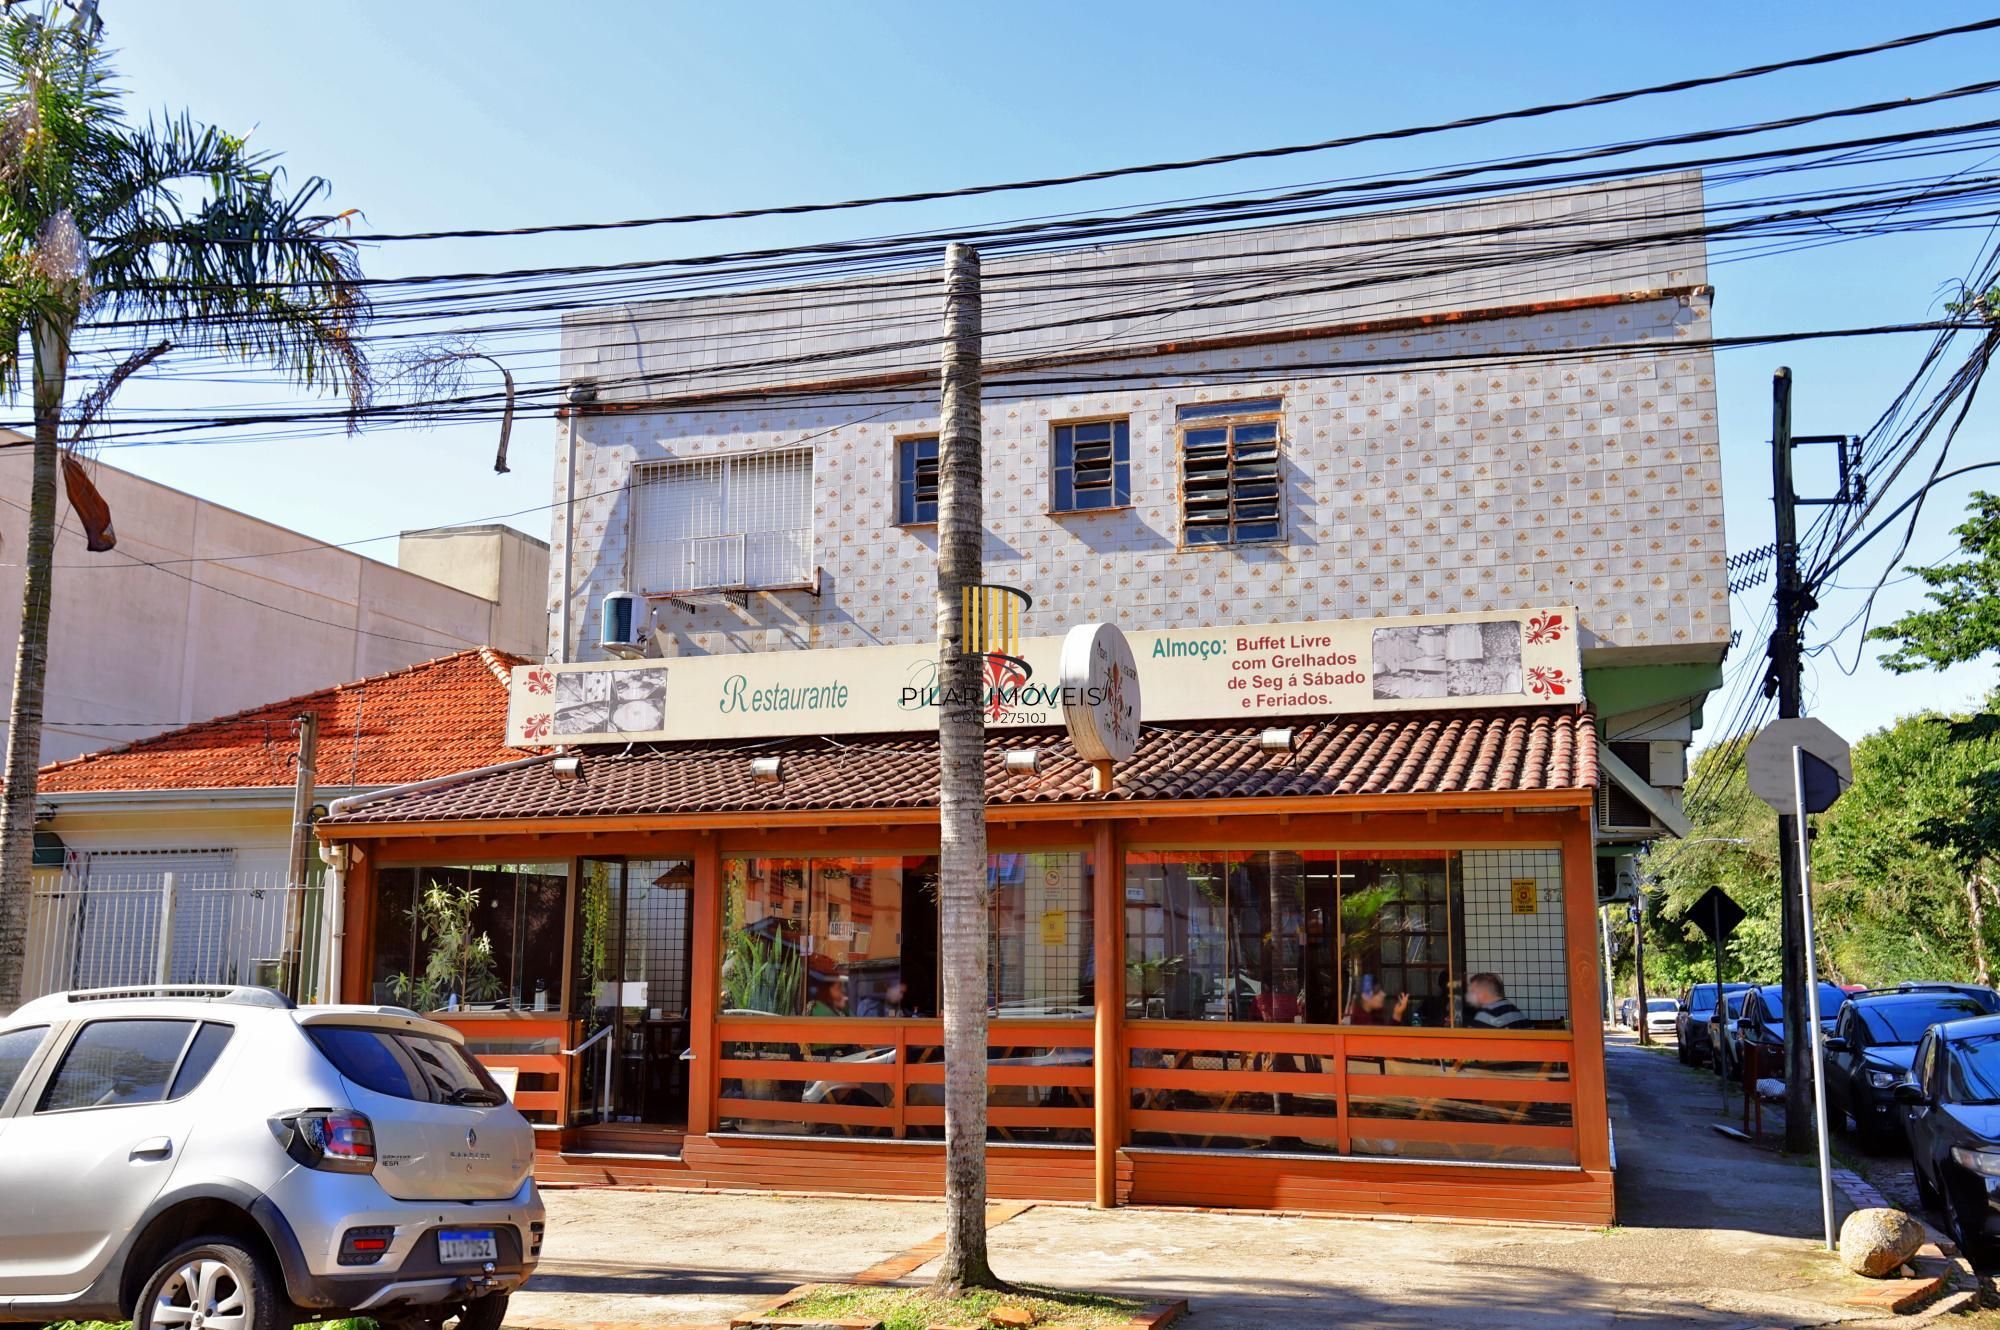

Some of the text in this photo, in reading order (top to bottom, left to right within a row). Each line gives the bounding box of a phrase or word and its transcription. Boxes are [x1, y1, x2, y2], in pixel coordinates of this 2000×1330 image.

[1152, 637, 1227, 661] Almoço:
[1236, 635, 1332, 651] Buffet Livre
[1231, 652, 1357, 670] com Grelhados
[1227, 670, 1366, 691] de Seg á Sábado
[719, 674, 849, 714] Restaurante
[1241, 692, 1333, 708] e Feriados.
